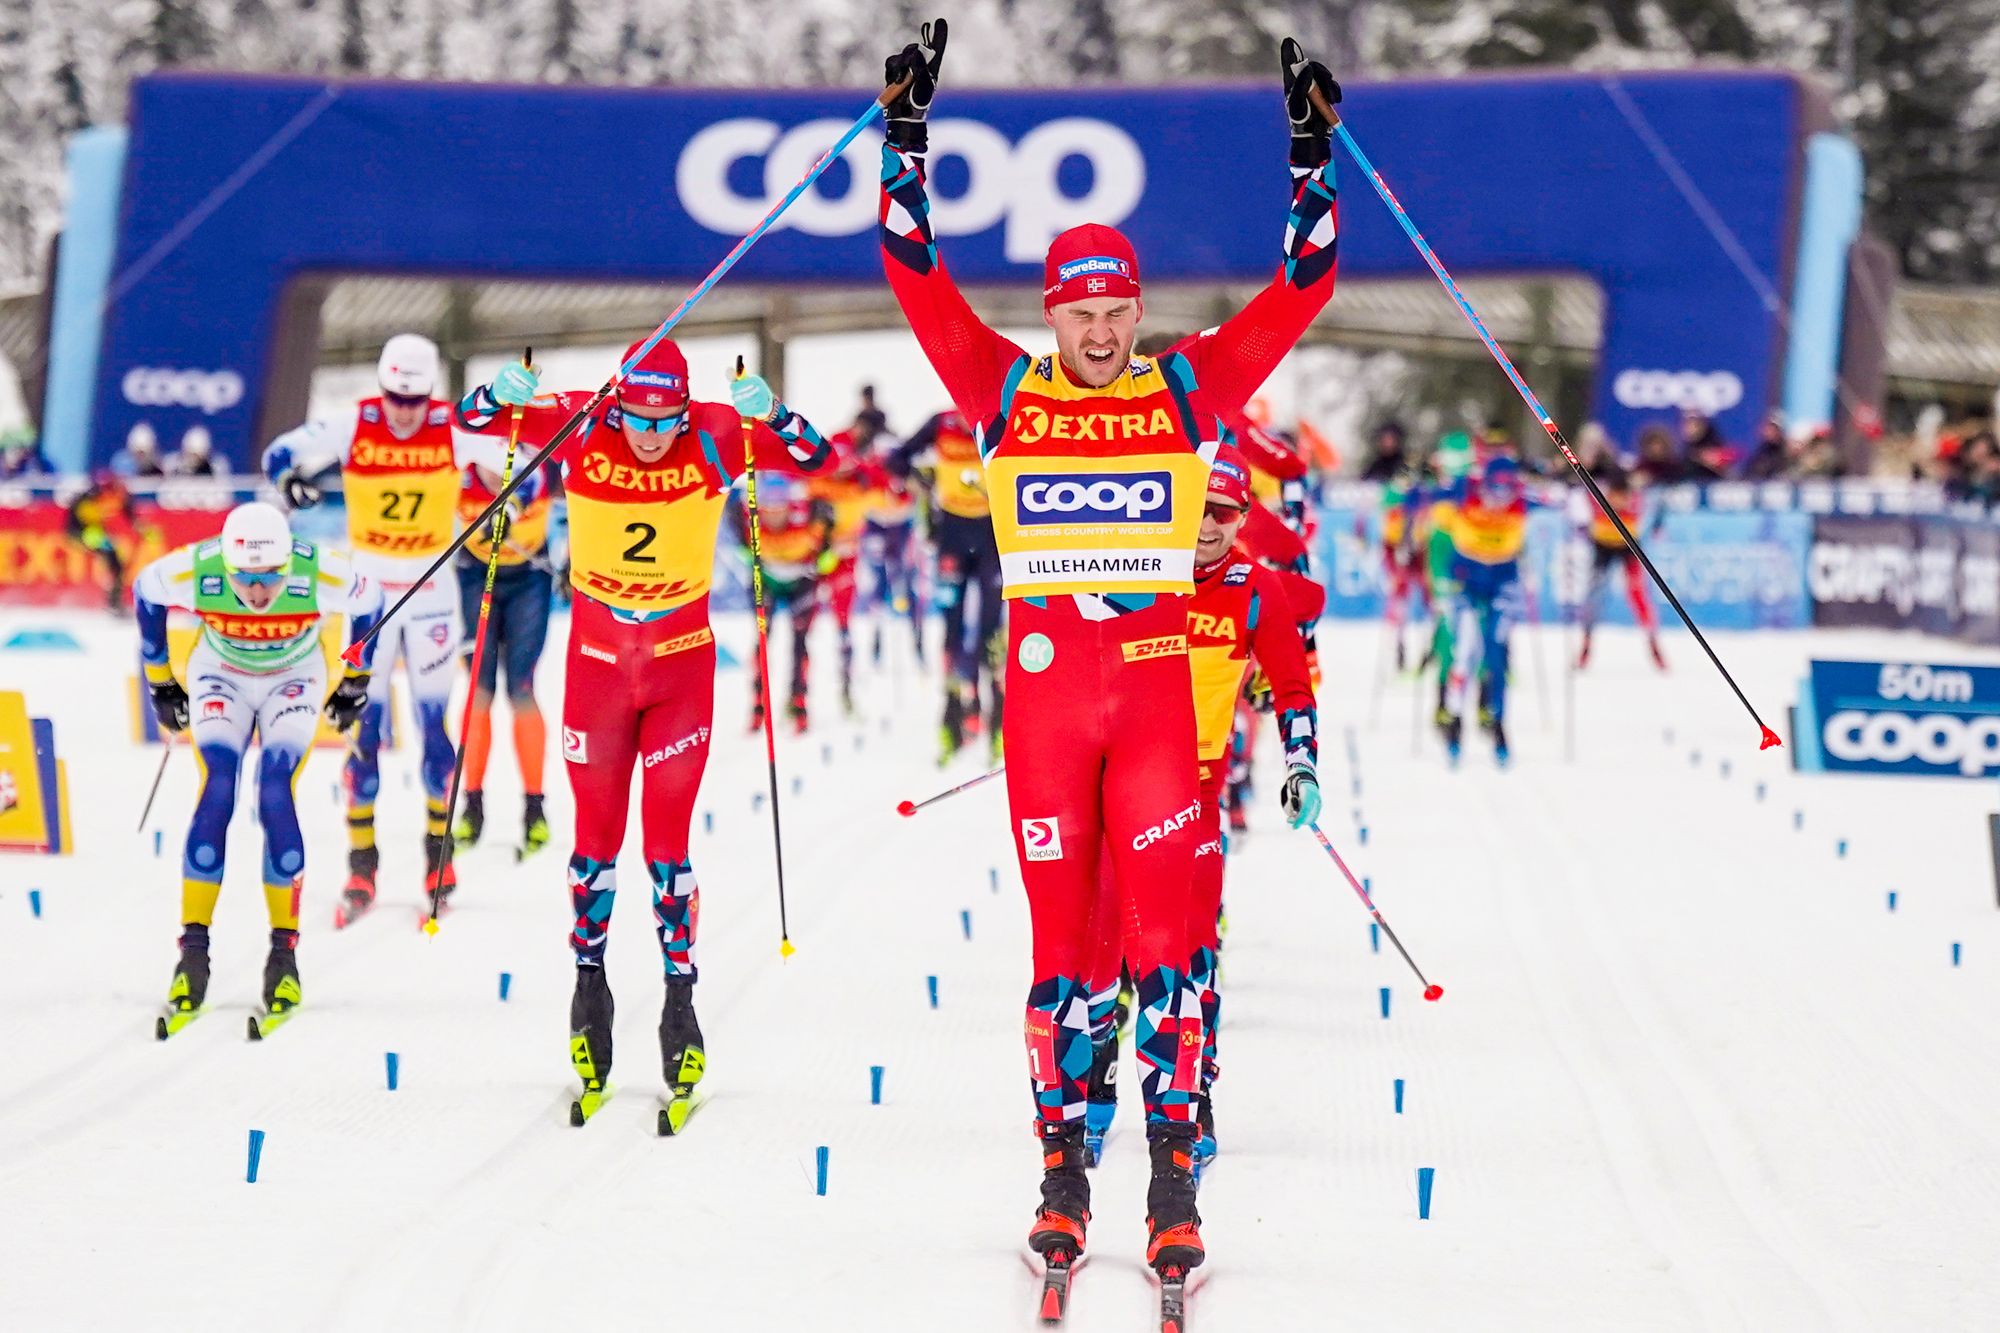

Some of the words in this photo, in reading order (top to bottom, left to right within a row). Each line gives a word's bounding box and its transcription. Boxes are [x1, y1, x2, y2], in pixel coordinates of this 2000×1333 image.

[675, 117, 1146, 263] coop
[1061, 259, 1117, 280] SpareBank
[121, 366, 245, 415] coop
[627, 373, 672, 387] SpareBank
[1613, 368, 1744, 417] coop
[1051, 408, 1174, 440] EXTRA
[373, 446, 451, 468] EXTRA
[610, 464, 704, 492] EXTRA
[380, 492, 424, 520] 27
[1022, 480, 1165, 518] coop
[367, 530, 434, 549] DHL
[622, 522, 657, 563] 2
[1030, 527, 1061, 537] CROSS
[1064, 526, 1113, 536] COUNTRY
[1118, 526, 1153, 535] WORLD
[1156, 526, 1173, 535] CUP
[611, 568, 665, 578] LILLEHAMMER
[1029, 559, 1162, 574] LILLEHAMMER
[587, 571, 692, 601] DHL
[581, 644, 617, 665] ELDORADO
[664, 633, 705, 652] DHL
[1134, 639, 1184, 656] DHL
[1878, 664, 1974, 703] 50m
[645, 732, 701, 768] CRAFT
[1823, 710, 2000, 777] coop
[1132, 805, 1197, 851] CRAFT
[1027, 848, 1060, 858] viaplay
[1030, 1048, 1041, 1075] 1
